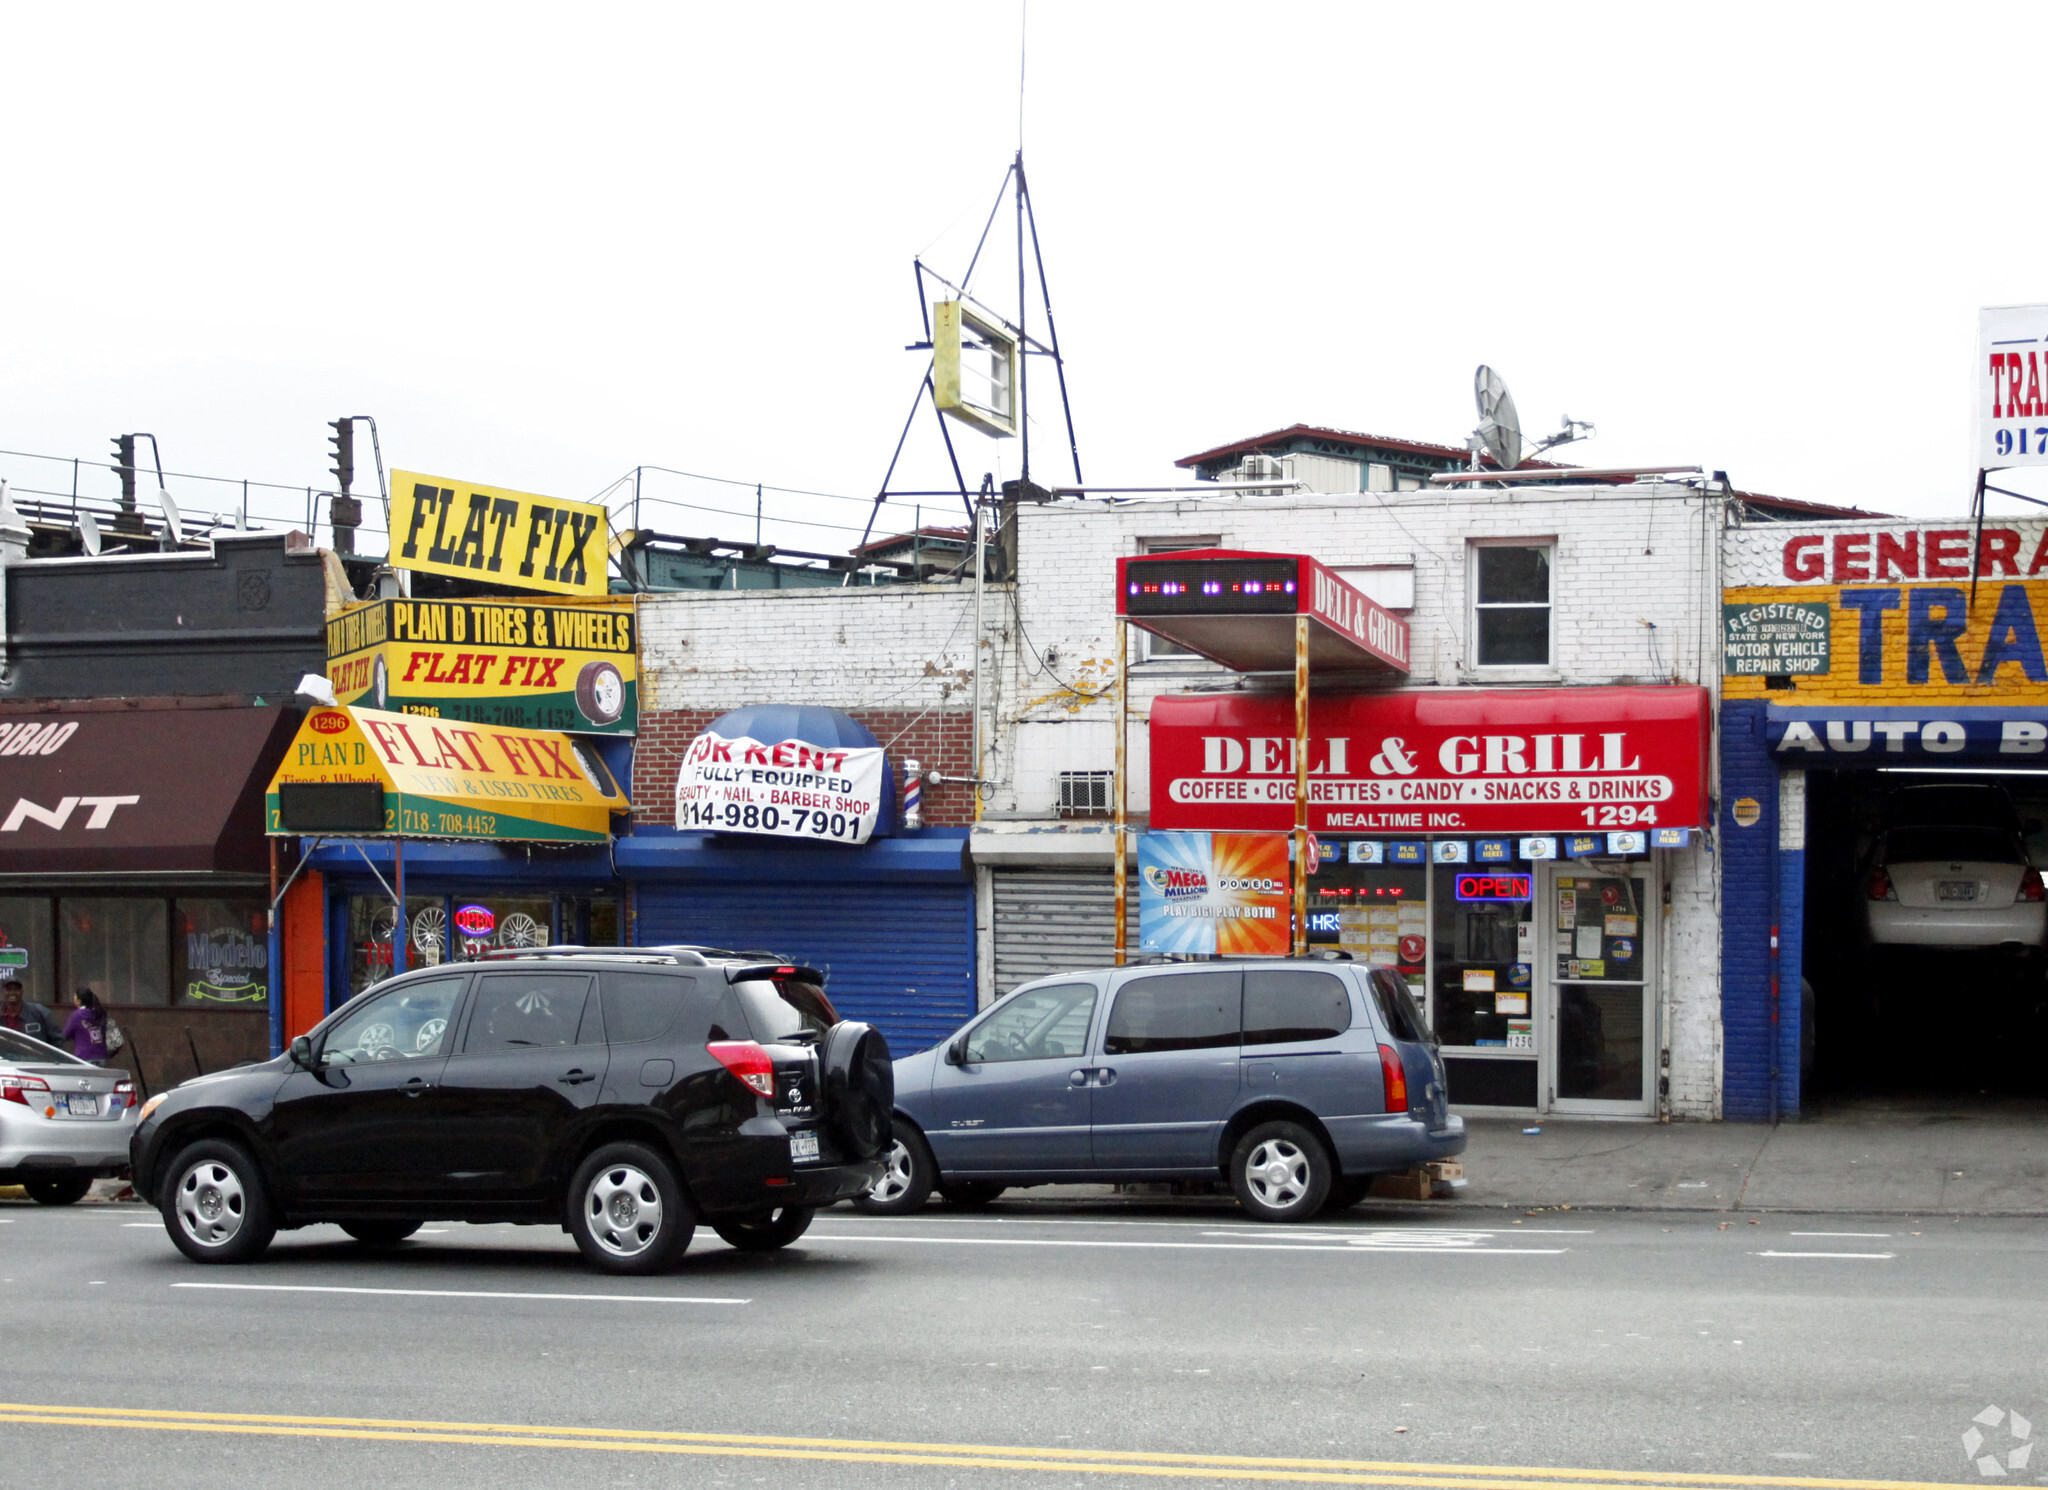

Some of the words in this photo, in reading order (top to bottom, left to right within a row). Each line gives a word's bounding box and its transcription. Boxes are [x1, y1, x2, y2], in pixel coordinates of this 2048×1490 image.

[1990, 351, 2048, 418] TRA
[1995, 427, 2048, 456] 917
[401, 483, 518, 572] FLAT
[519, 504, 598, 586] FIX
[394, 602, 446, 641] PLAN
[452, 605, 466, 642] B
[471, 606, 527, 645] TIRES
[533, 609, 548, 646] &
[553, 611, 630, 651] WHEELS
[1314, 568, 1351, 631] DELI
[1354, 598, 1365, 640] &
[1368, 607, 1407, 663] GRILL
[1728, 604, 1825, 631] REGISTERED
[1729, 633, 1757, 641] STATE
[1775, 632, 1797, 640] NEW
[1800, 632, 1825, 640] YORK
[1840, 584, 2048, 685] TRA
[1728, 643, 1770, 657] MOTOR
[1774, 642, 1827, 657] VEHICLE
[332, 664, 353, 694] FLAT
[353, 656, 370, 690] FIX
[402, 652, 497, 685] FLAT
[499, 656, 565, 687] FIX
[1736, 658, 1781, 672] REPAIR
[1785, 657, 1820, 671] SHOP
[401, 704, 440, 719] 1296
[314, 717, 346, 730] 1296
[1775, 720, 1966, 752] AUTO
[298, 743, 347, 765] PLAN
[354, 743, 365, 765] D
[362, 719, 494, 773] FLAT
[490, 734, 583, 780] FIX
[688, 736, 734, 765] FOR
[745, 743, 849, 773] RENT
[1201, 737, 1350, 774] DELI
[1369, 737, 1418, 775] &
[1438, 733, 1639, 775] GRILL
[412, 775, 459, 793] NEW
[463, 779, 480, 795] &
[482, 780, 528, 798] USED
[528, 784, 583, 801] TIRES
[695, 766, 744, 782] FULLY
[752, 770, 853, 793] EQUIPPED
[1179, 781, 1247, 799] COFFEE
[1266, 782, 1380, 801] CIGRETTES
[1400, 783, 1464, 801] CANDY
[1484, 782, 1560, 800] SNACKS
[1567, 782, 1581, 799] &
[1589, 780, 1662, 799] DRINKS
[679, 785, 711, 800] BEAUTY
[723, 786, 754, 802] NAIL
[771, 790, 831, 809] BARBER
[835, 796, 870, 815] SHOP
[0, 795, 140, 831] NT
[403, 809, 429, 832] 718
[683, 802, 861, 840] 914-980-7901
[1327, 813, 1422, 827] MEALTIME
[1428, 812, 1466, 827] INC.
[1580, 805, 1657, 826] 1294
[1574, 838, 1591, 846] PLAY
[1659, 836, 1681, 844] HERE!
[1661, 829, 1679, 837] PLAY
[1318, 851, 1334, 859] ERE!
[1573, 843, 1594, 852] HERE!
[1166, 870, 1207, 887] MEGA
[1459, 878, 1529, 897] OPEN
[1164, 887, 1208, 898] MILLIONS
[455, 911, 496, 930] OPEN
[1163, 904, 1188, 917] PLAY
[1191, 906, 1214, 917] BIG!
[1216, 906, 1241, 918] PLAY
[1244, 906, 1276, 918] BOTH!
[188, 933, 267, 969] Modelo
[364, 942, 415, 965] TIRS
[206, 968, 250, 986] Especial
